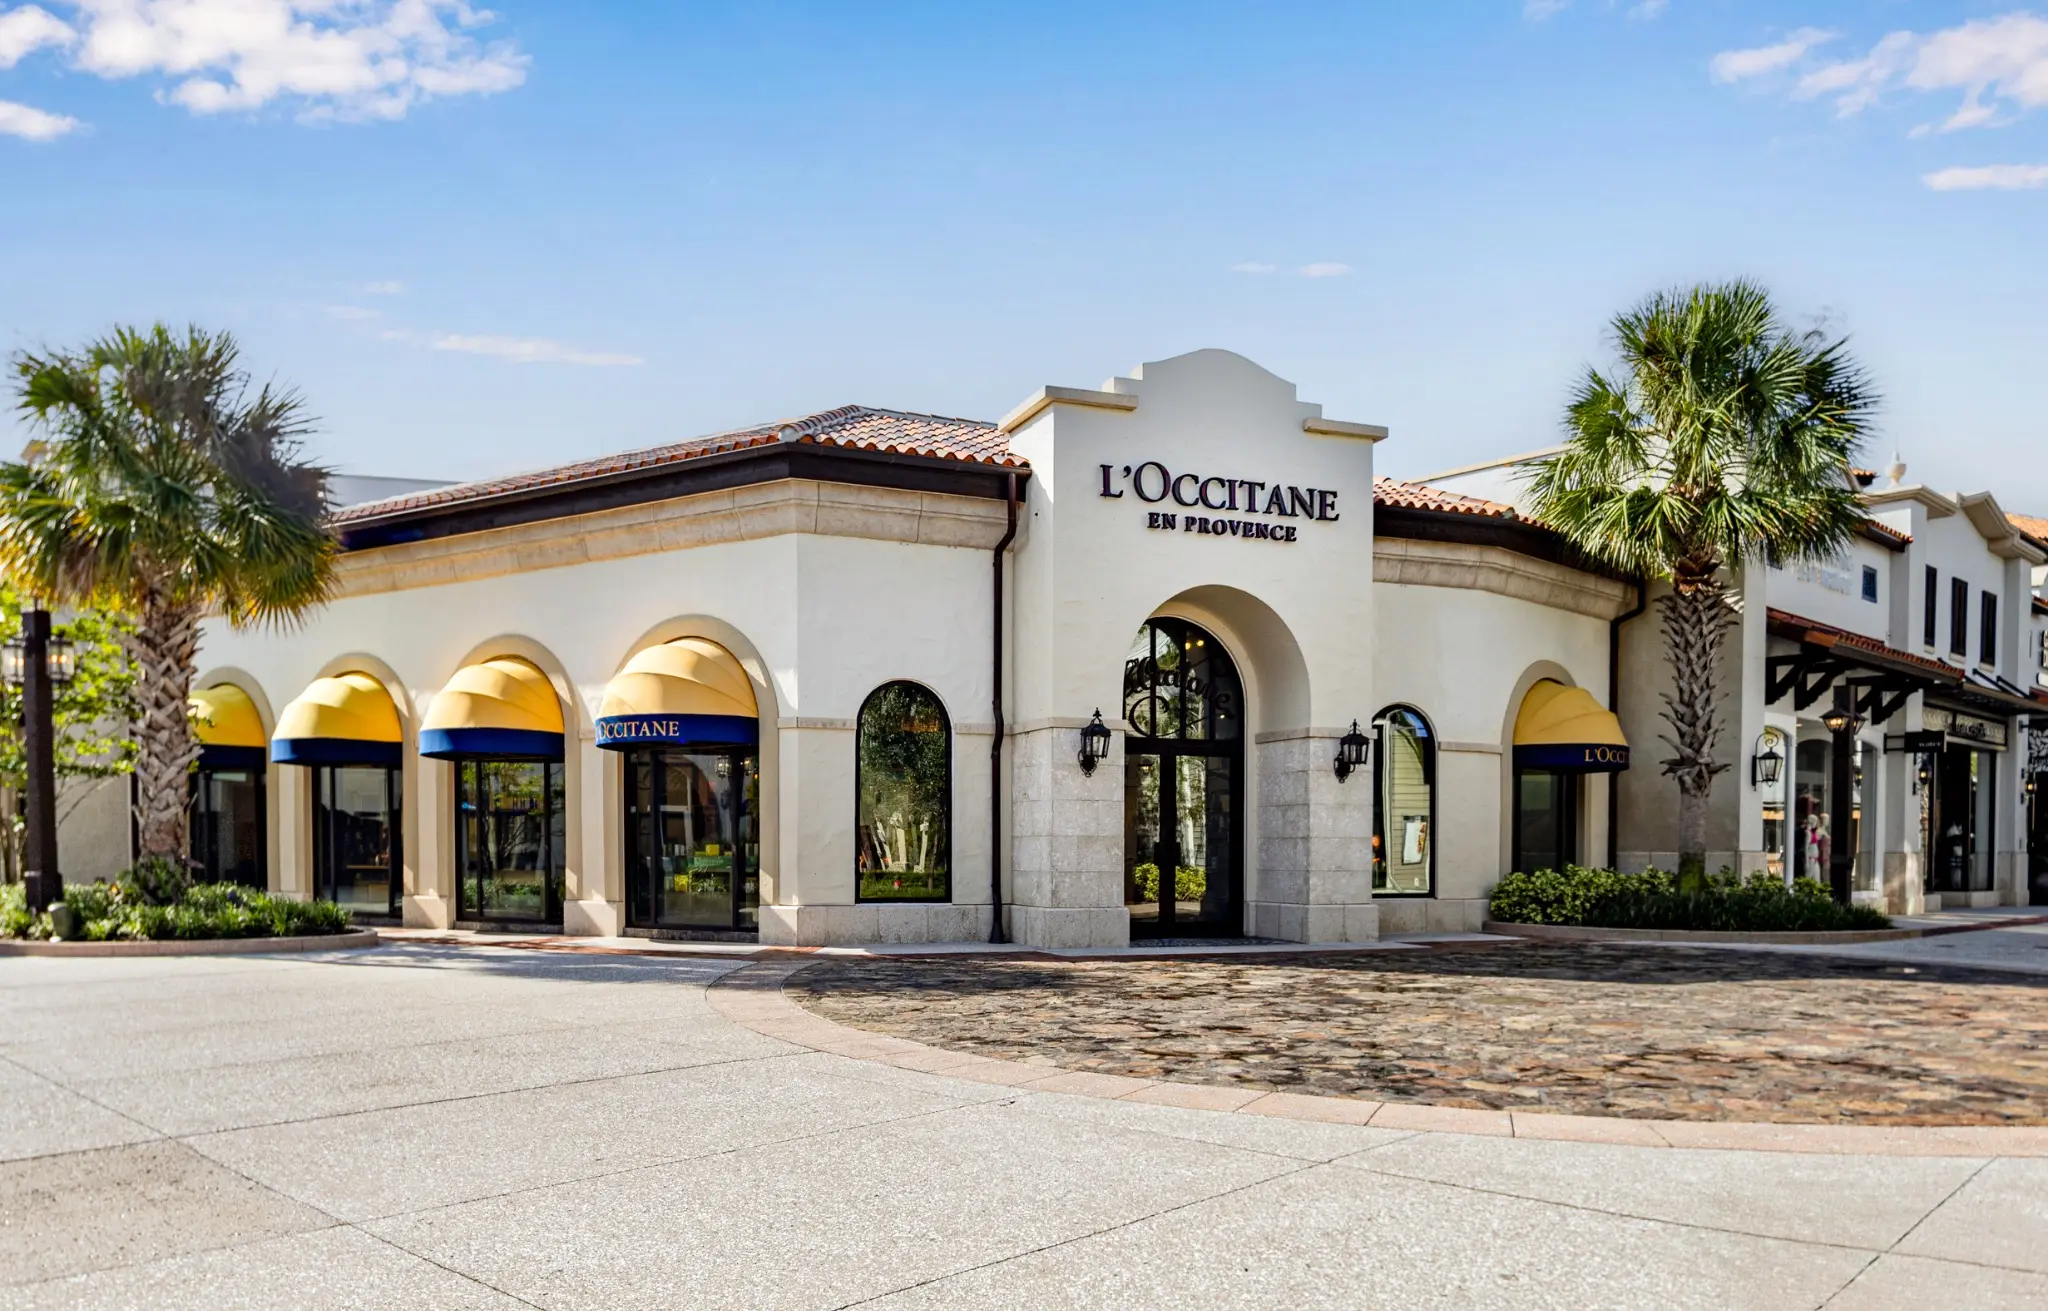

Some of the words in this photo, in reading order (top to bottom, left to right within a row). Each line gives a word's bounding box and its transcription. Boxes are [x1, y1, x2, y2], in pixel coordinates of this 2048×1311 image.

[1099, 461, 1340, 521] L'OCCITANE
[1147, 512, 1177, 531] EN
[1184, 516, 1297, 542] PROVENCE
[598, 720, 680, 739] OCCITANE
